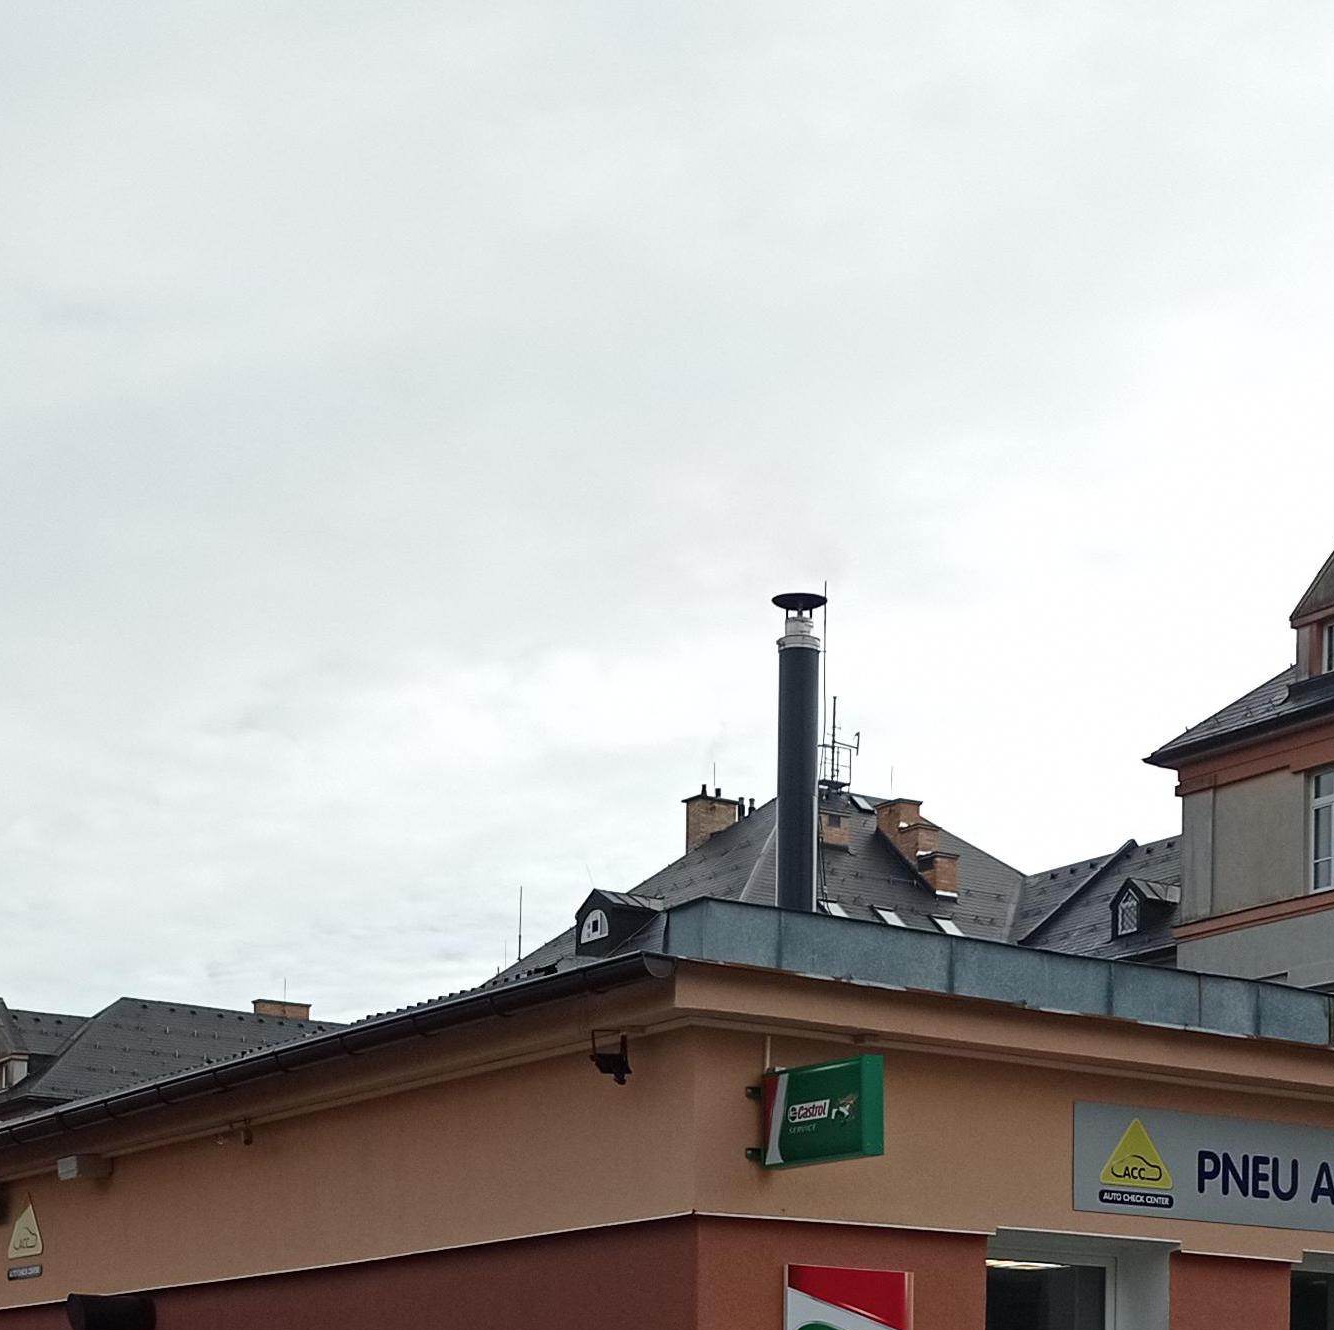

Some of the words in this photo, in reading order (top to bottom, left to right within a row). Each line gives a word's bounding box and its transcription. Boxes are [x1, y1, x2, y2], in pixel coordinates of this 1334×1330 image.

[798, 1101, 827, 1119] Castrol
[1123, 1165, 1146, 1181] ACC
[1196, 1149, 1299, 1202] PNEU
[1103, 1191, 1122, 1202] AUTO
[1123, 1193, 1144, 1204] CHECK
[1146, 1195, 1170, 1206] CENTER
